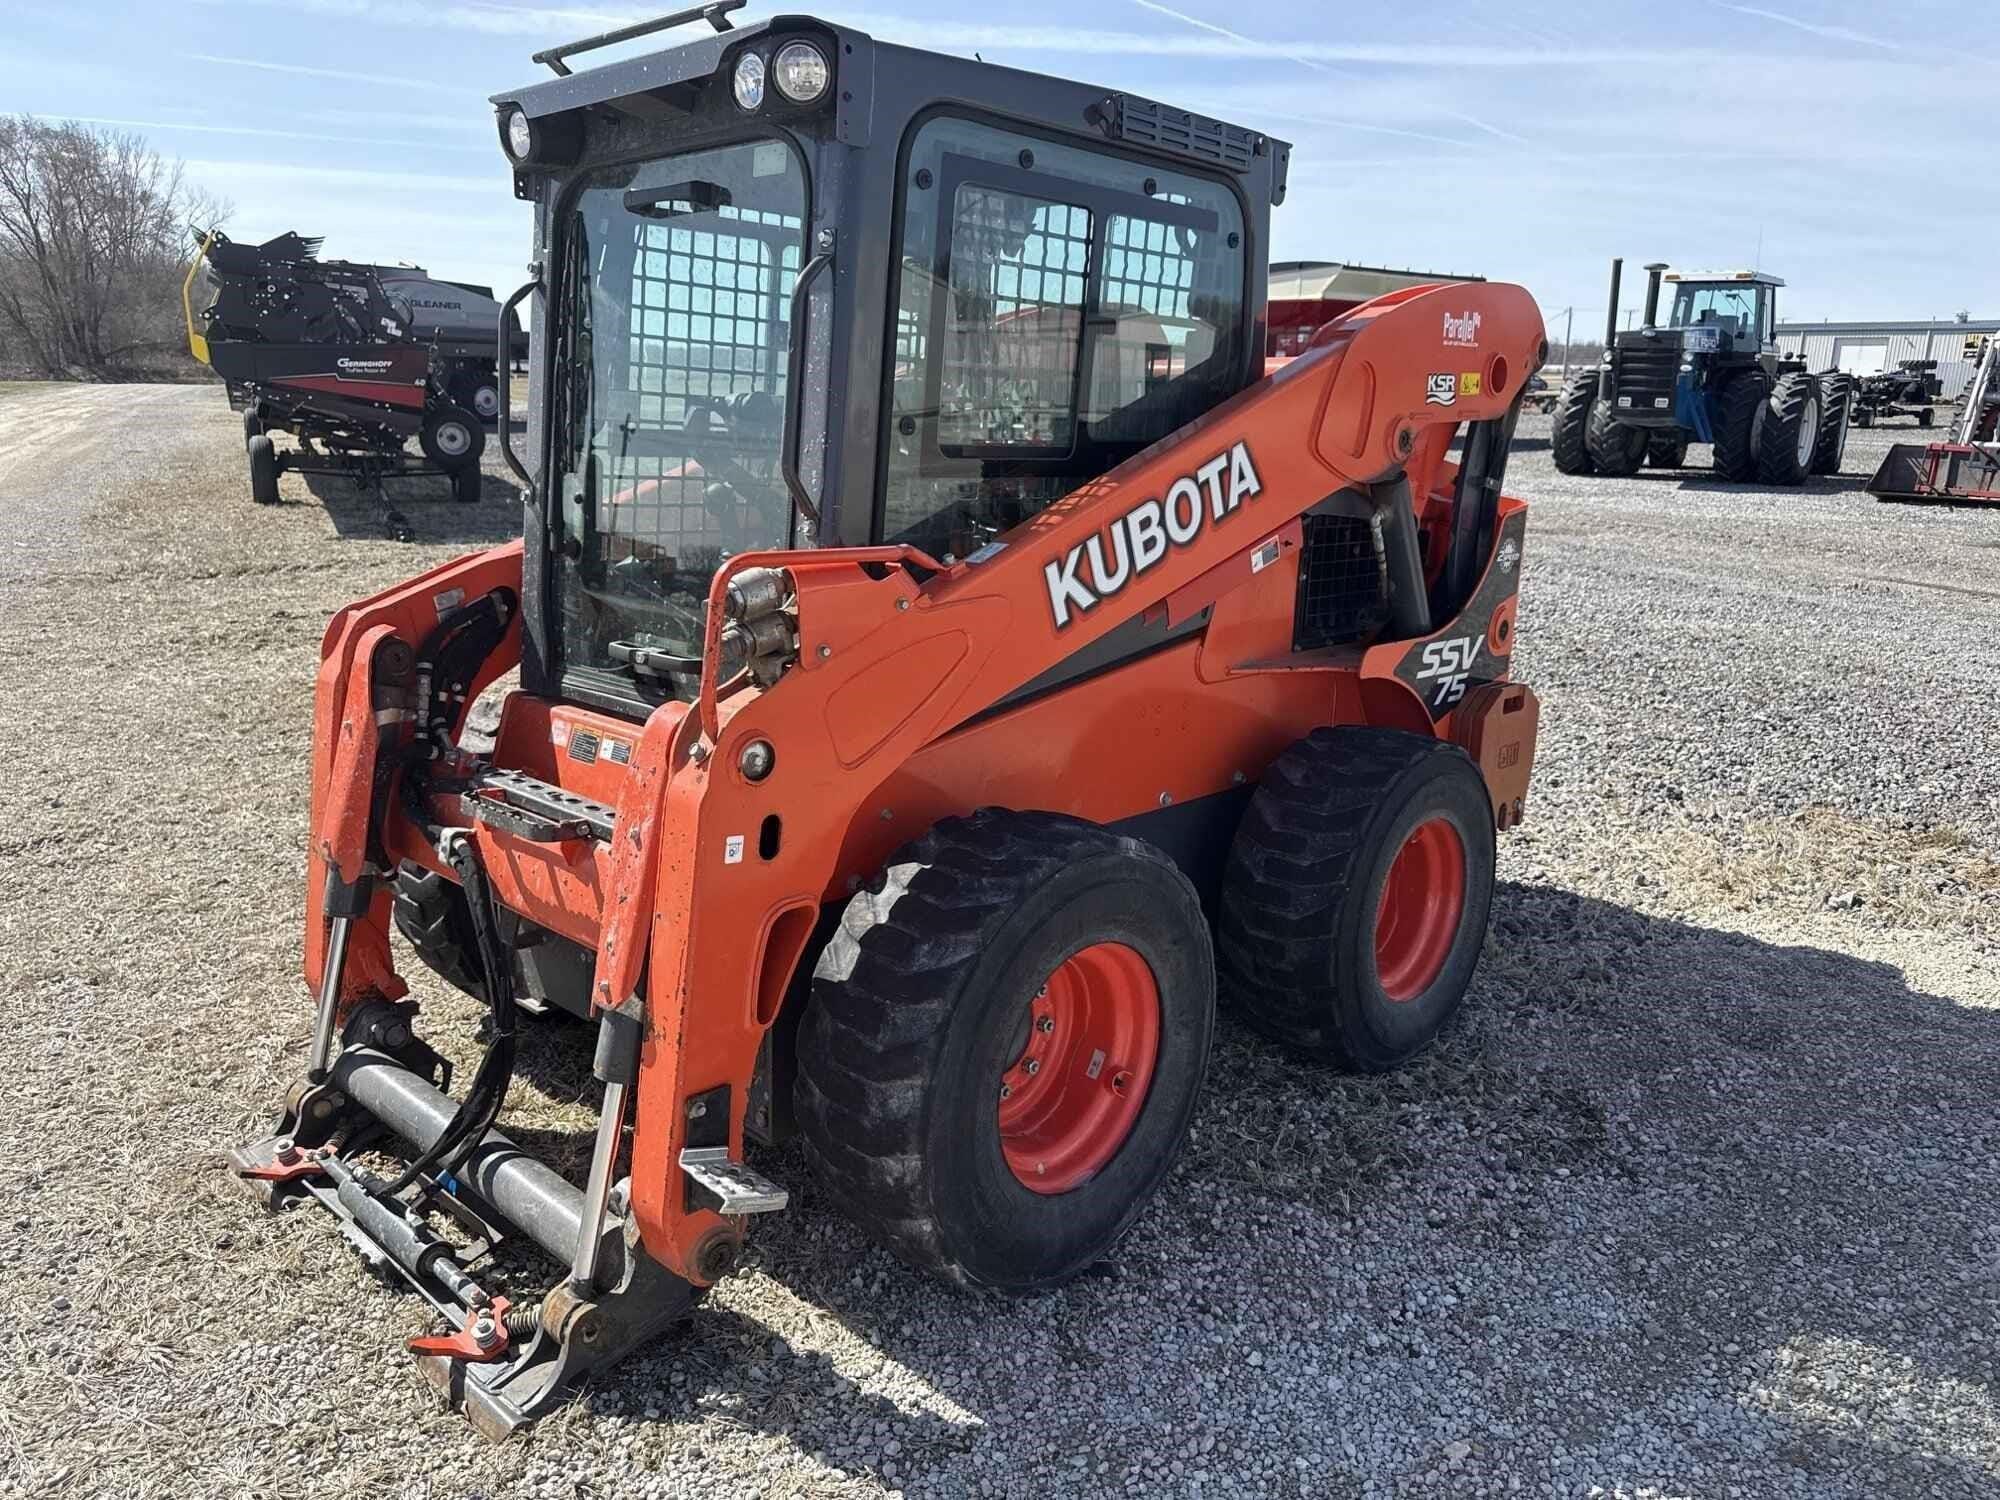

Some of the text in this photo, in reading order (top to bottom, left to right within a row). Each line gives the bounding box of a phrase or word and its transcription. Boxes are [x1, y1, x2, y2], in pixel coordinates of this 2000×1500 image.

[411, 300, 462, 310] GLEANER
[1427, 375, 1456, 392] KSR
[1044, 441, 1261, 629] KUBOTA
[1416, 634, 1486, 680] SSV
[1433, 672, 1469, 706] 75
